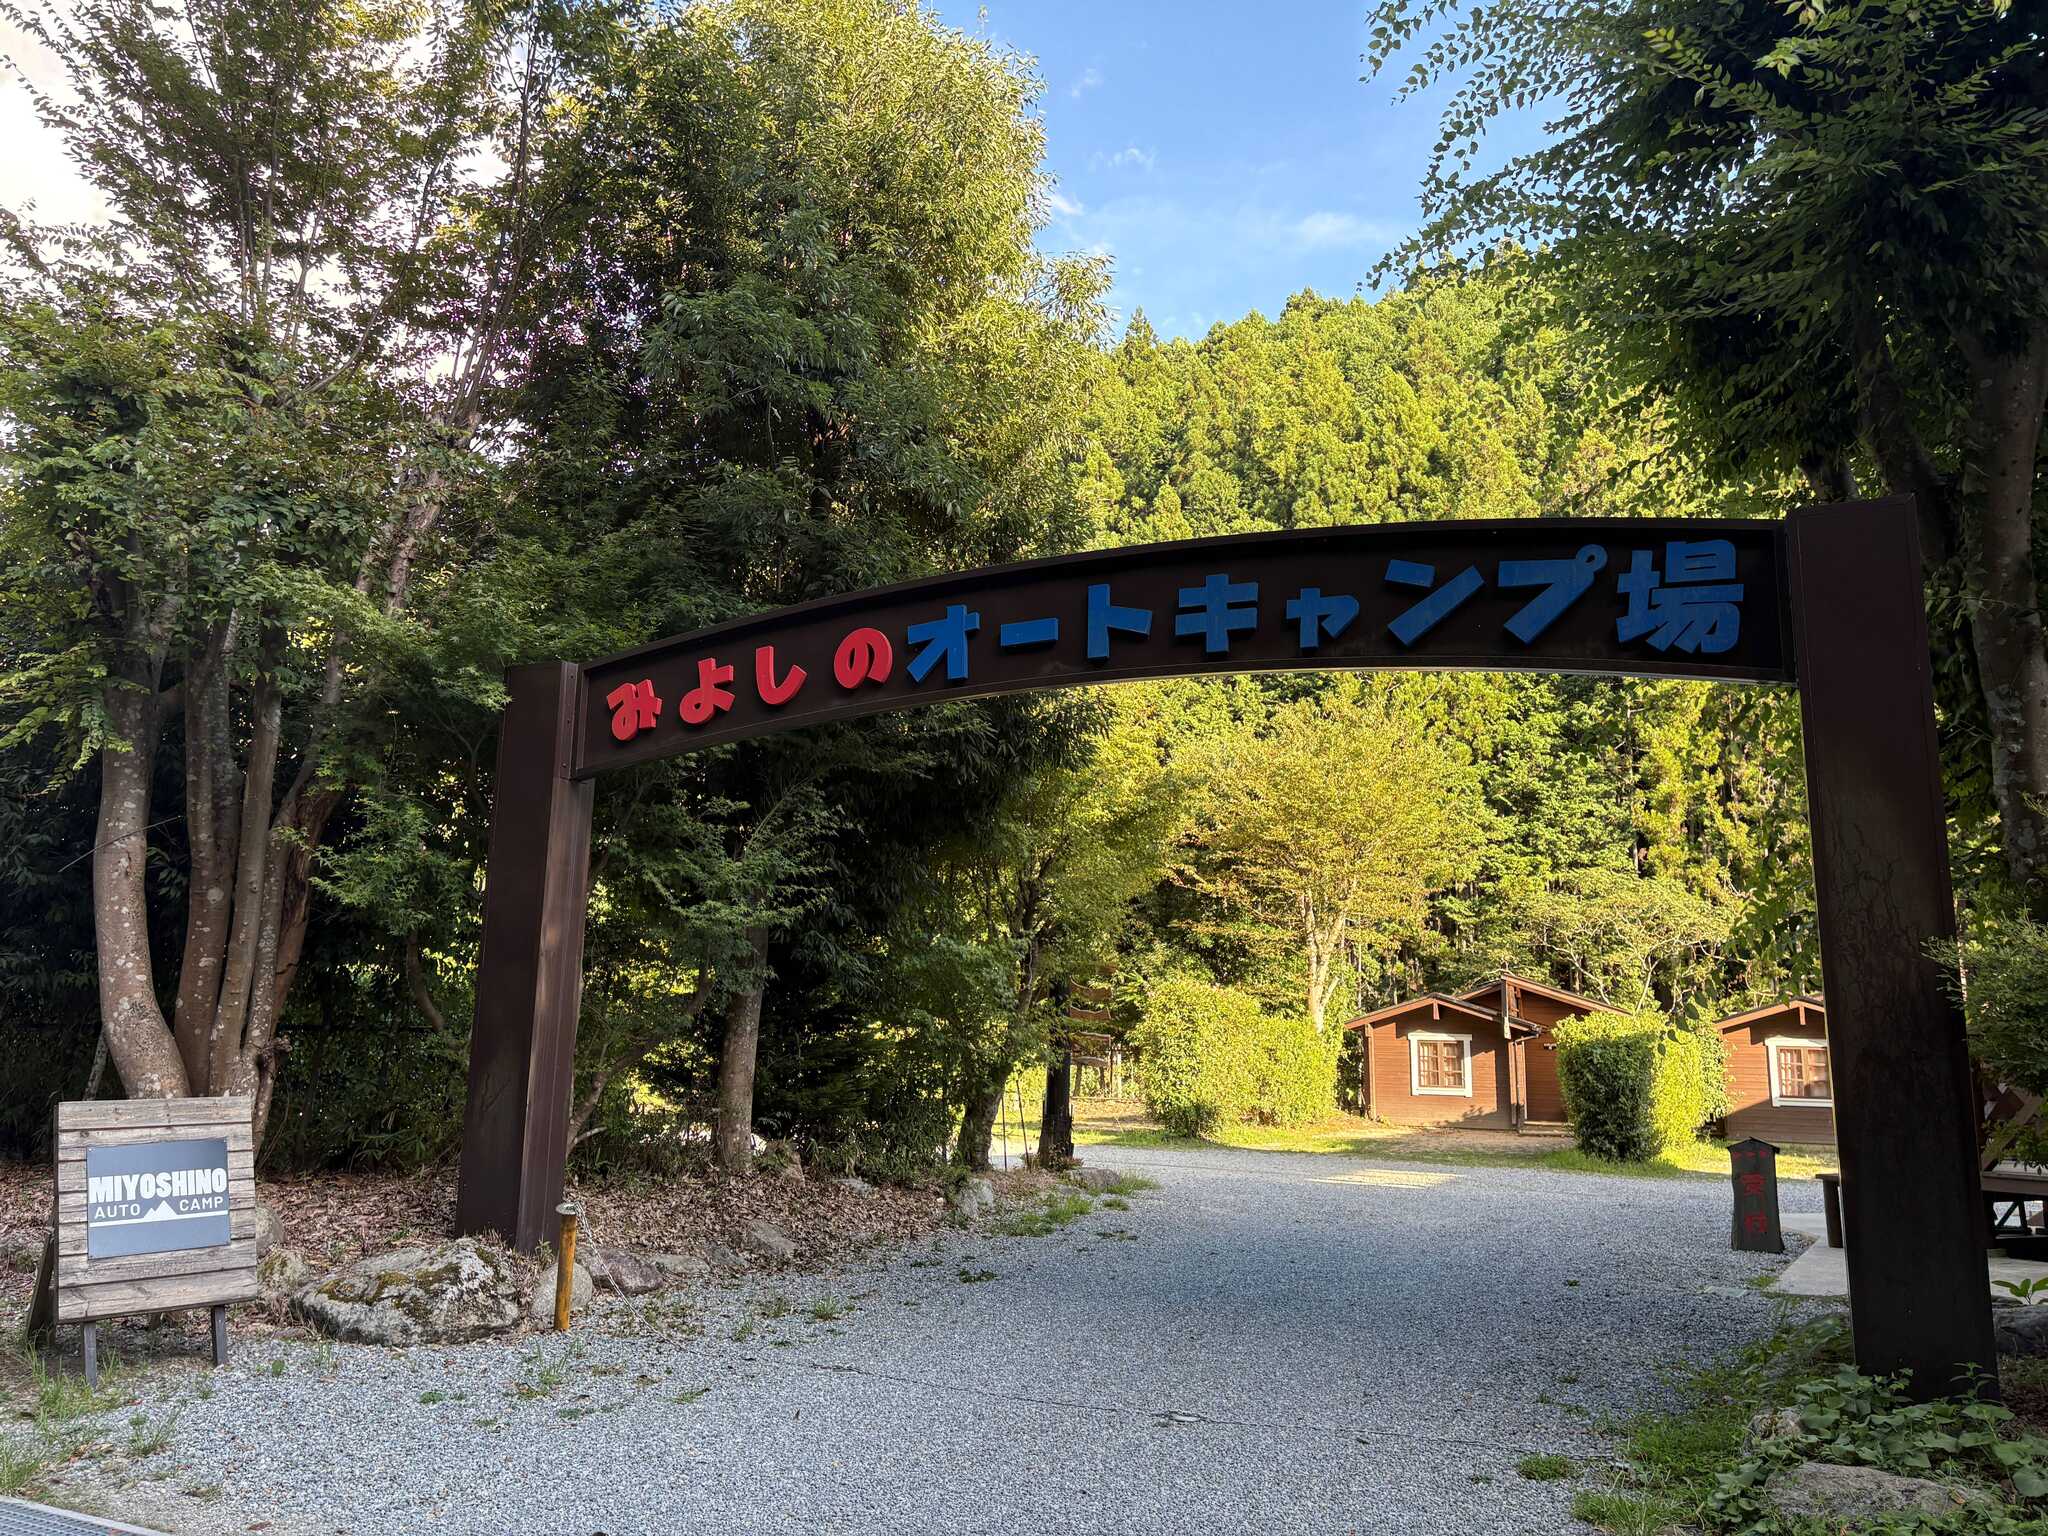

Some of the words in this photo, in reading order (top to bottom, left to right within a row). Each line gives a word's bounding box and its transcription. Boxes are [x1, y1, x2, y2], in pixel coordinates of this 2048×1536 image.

[606, 539, 1744, 741] みよしのオートキャンプ場
[89, 1168, 228, 1203] MIYOSHINO
[94, 1203, 141, 1219] AUTO
[179, 1196, 224, 1211] CAMP
